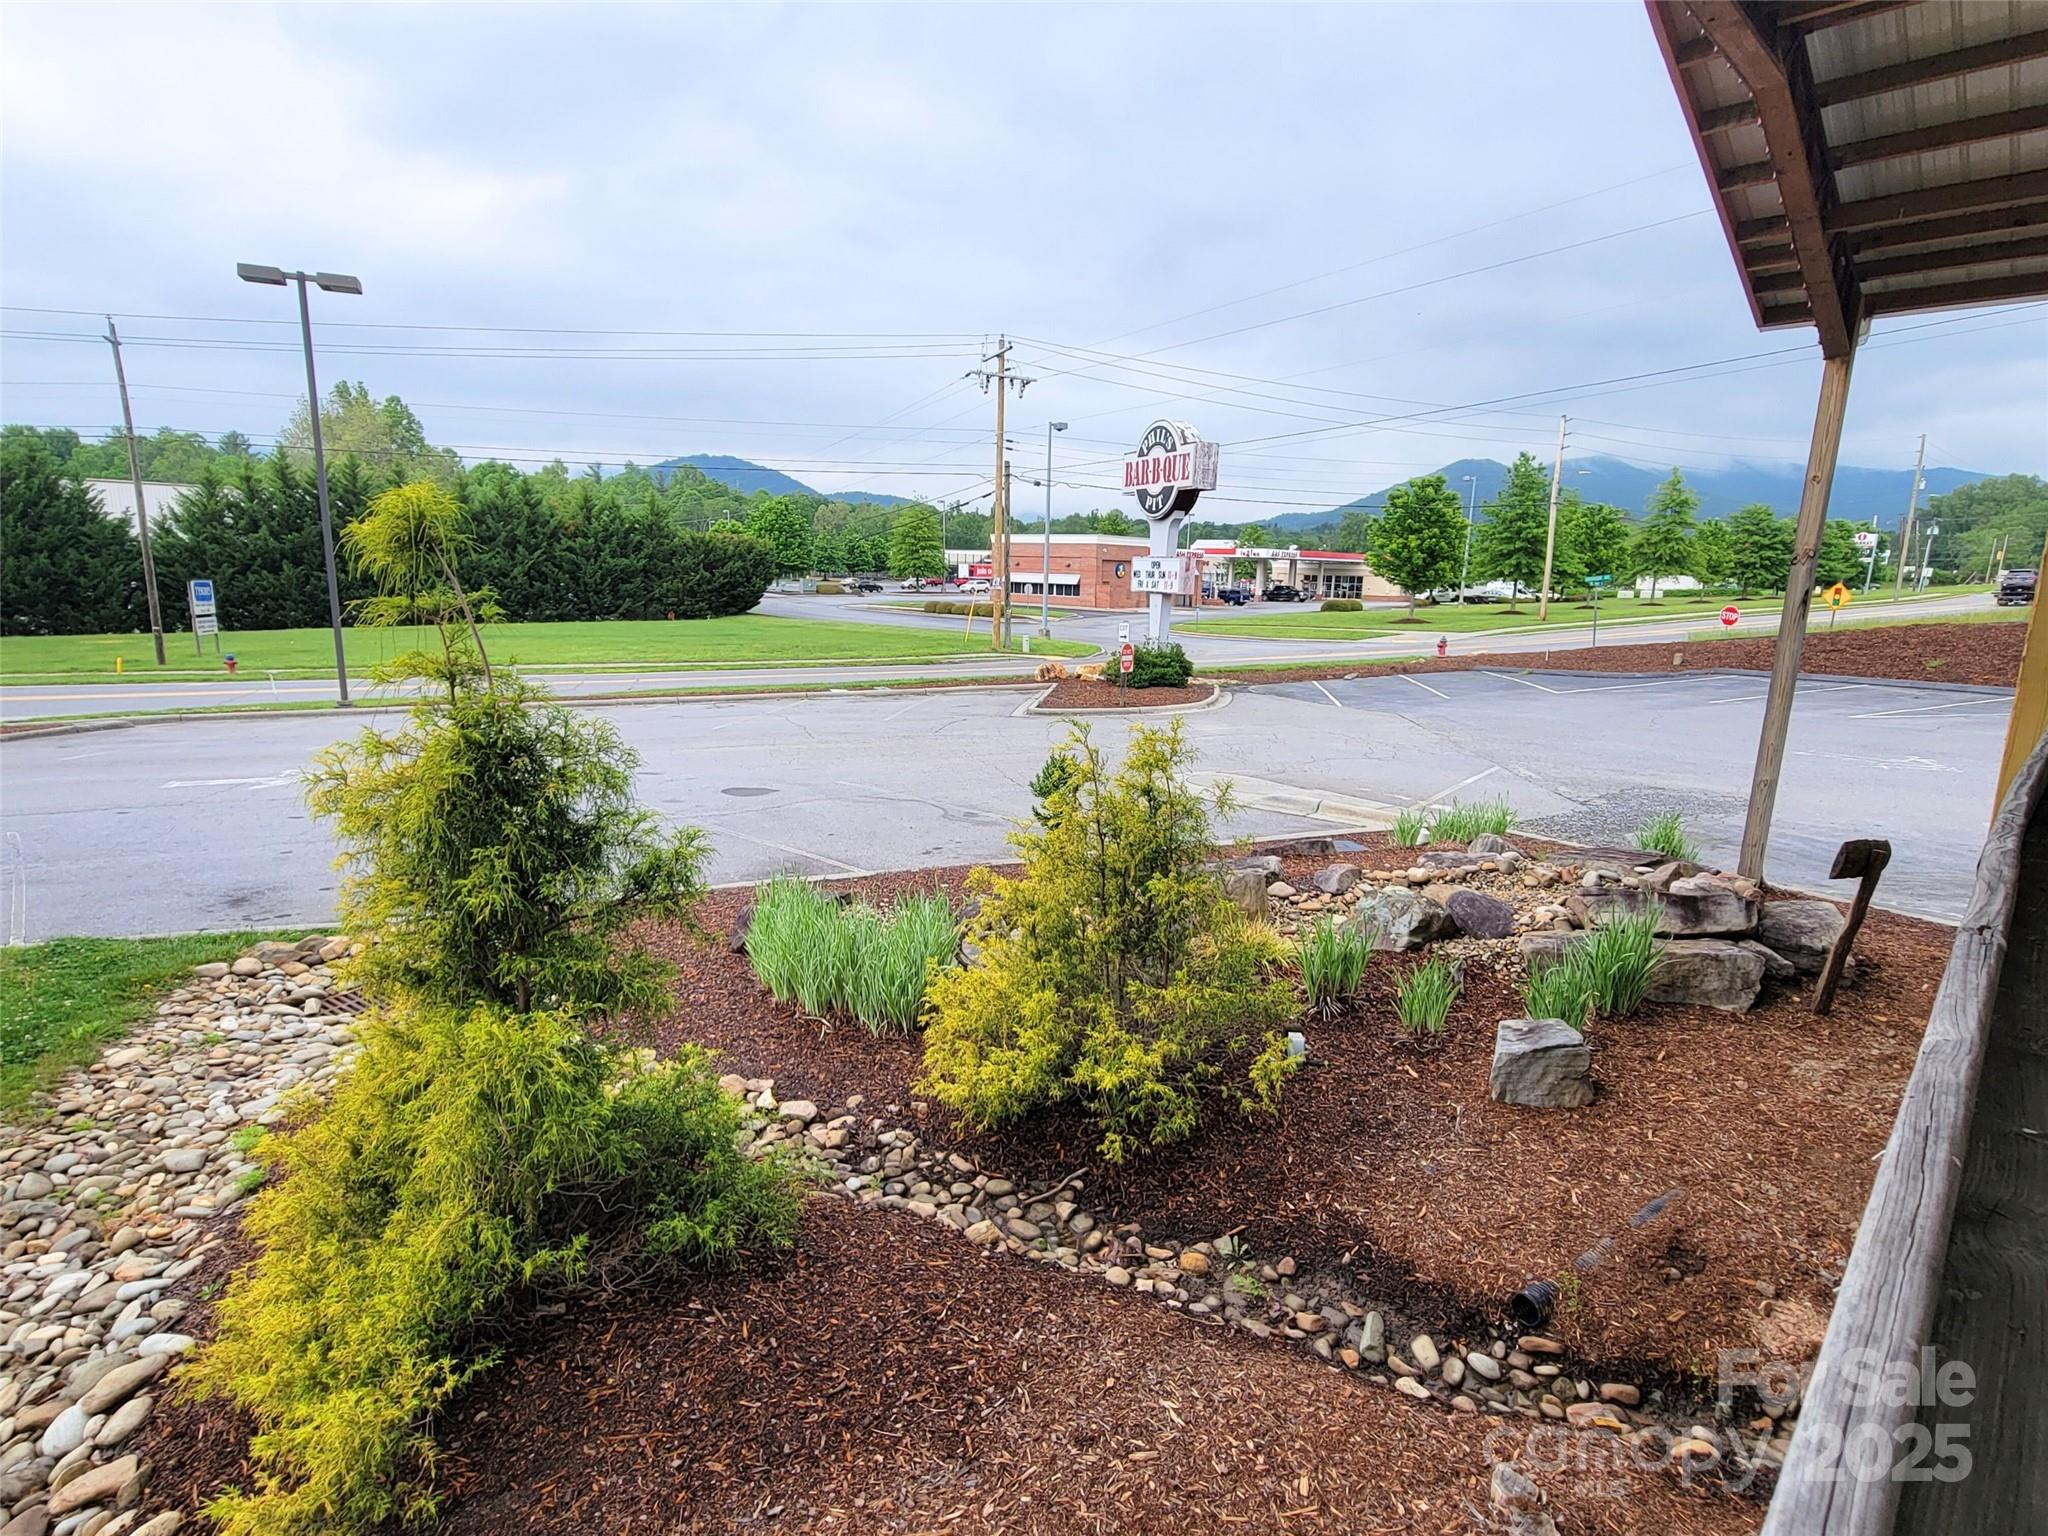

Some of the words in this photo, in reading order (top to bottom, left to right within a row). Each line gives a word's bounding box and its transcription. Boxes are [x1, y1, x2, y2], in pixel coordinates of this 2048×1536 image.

[1142, 428, 1174, 455] PHIL'S
[1145, 494, 1164, 511] PIT
[1151, 561, 1161, 569] OPEN
[1721, 611, 1739, 621] STOP
